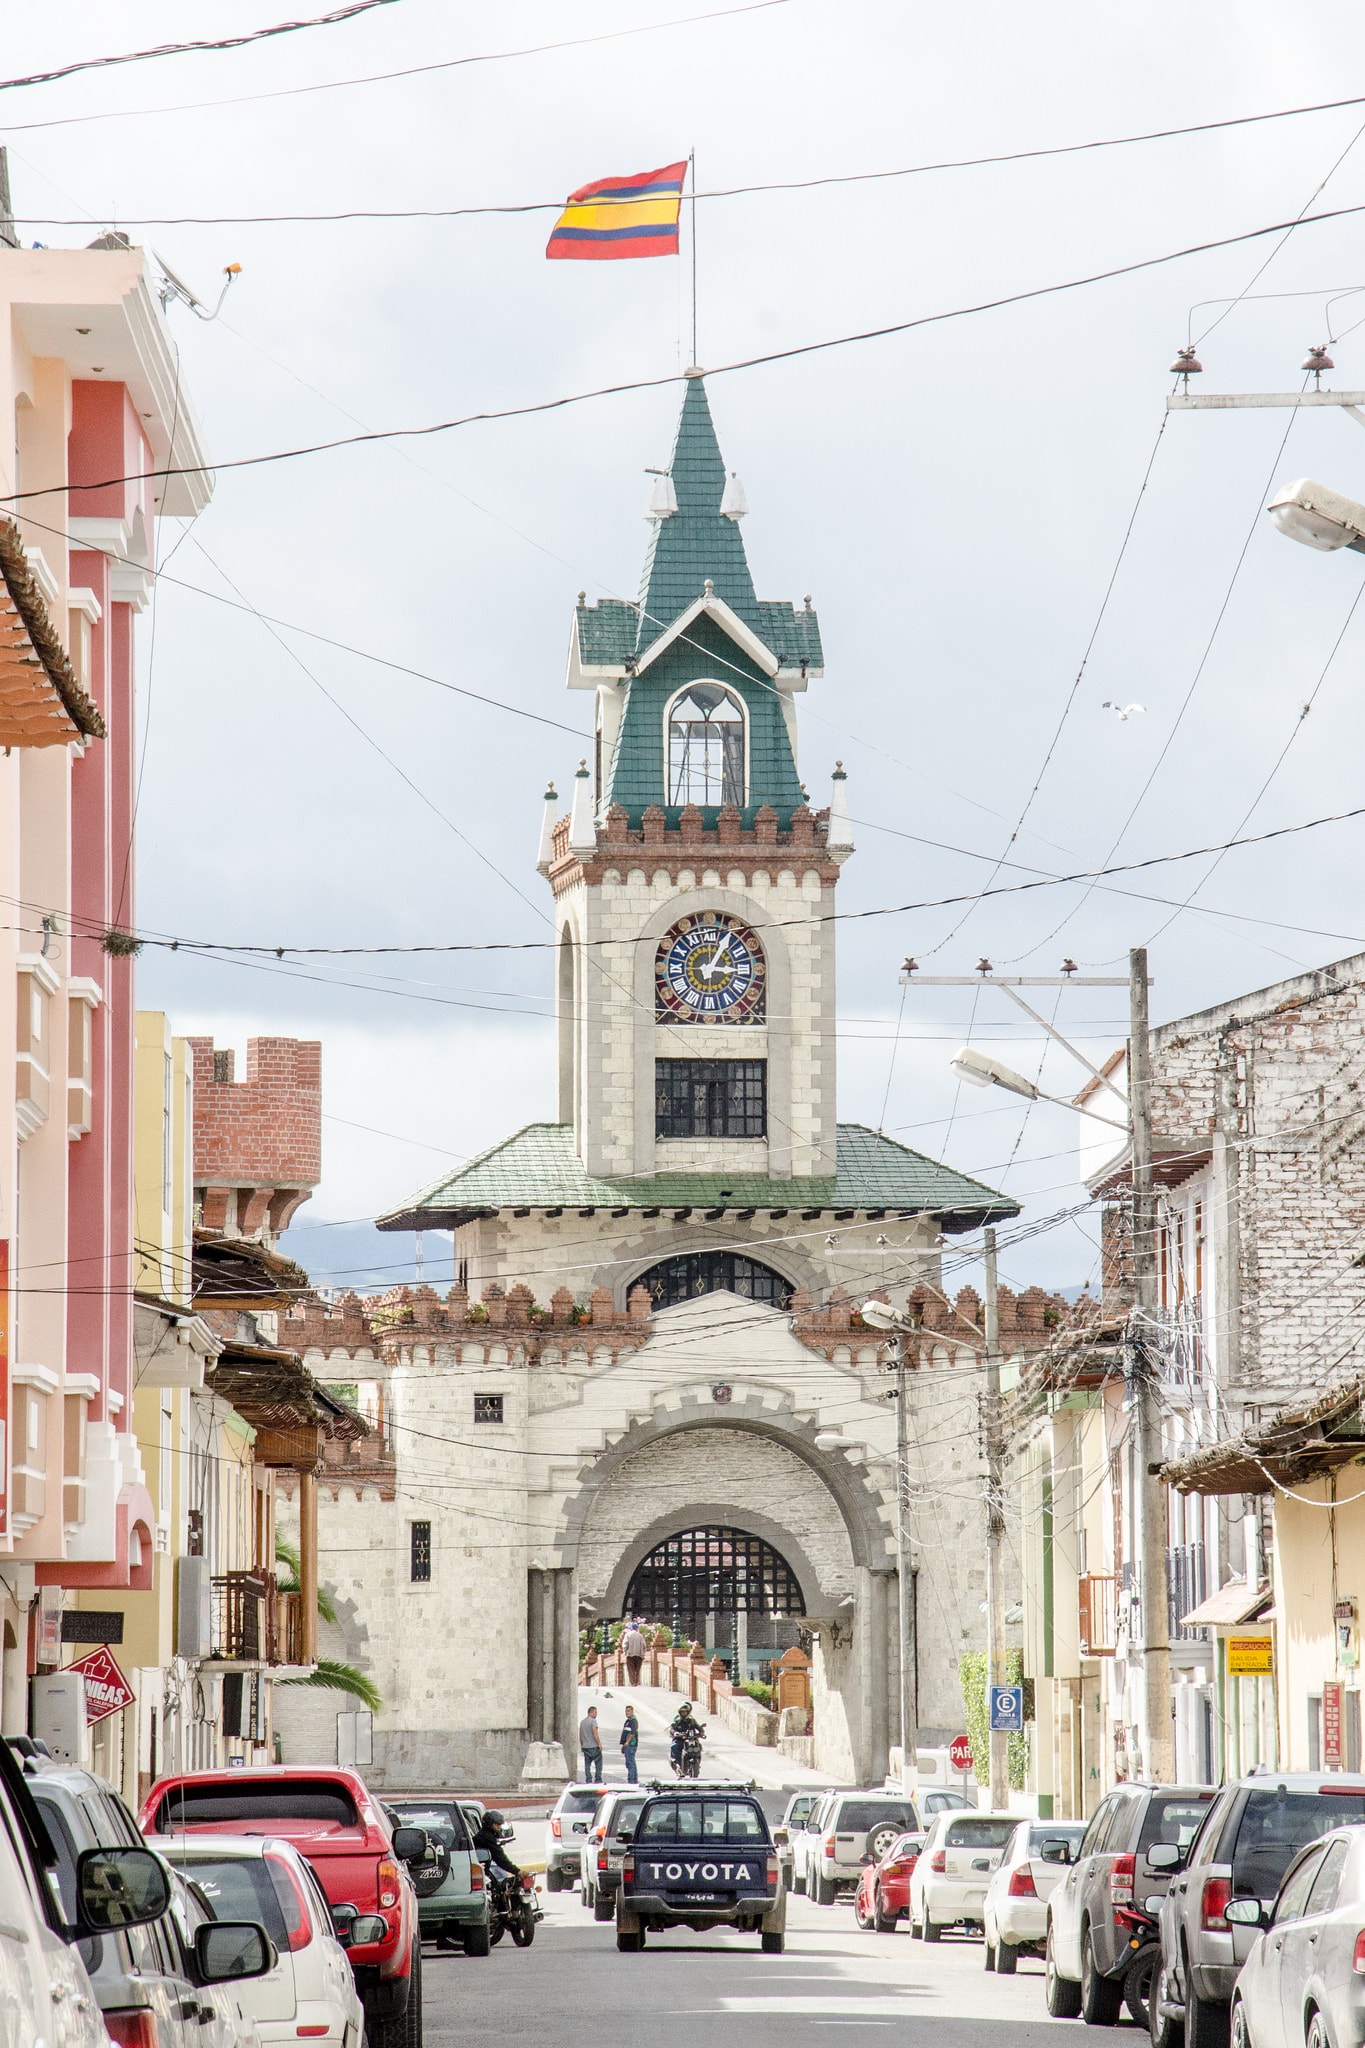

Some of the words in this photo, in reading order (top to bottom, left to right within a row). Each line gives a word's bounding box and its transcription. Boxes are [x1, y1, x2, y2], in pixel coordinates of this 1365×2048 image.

[674, 946, 687, 957] X
[732, 946, 746, 958] II
[669, 963, 683, 974] IX
[737, 964, 750, 975] III
[733, 980, 747, 994] IV
[704, 996, 715, 1009] VI
[723, 993, 733, 1005] V
[68, 1616, 117, 1627] SERVICIO
[85, 1679, 125, 1705] NIGAS
[1002, 1697, 1010, 1709] E
[951, 1746, 971, 1759] PAR
[650, 1863, 751, 1880] TOYOTA
